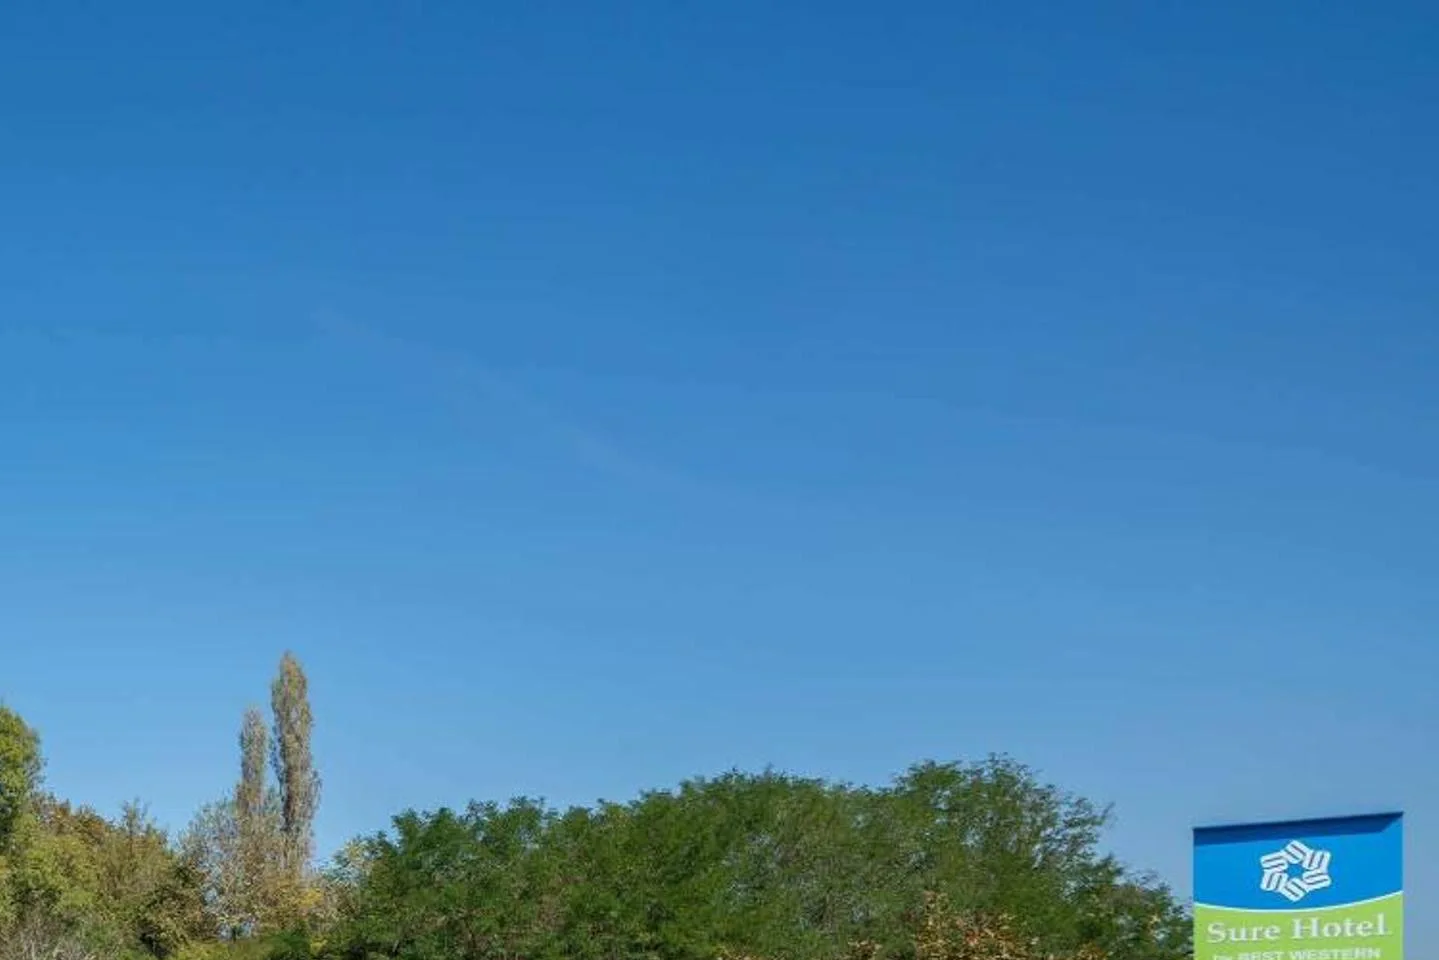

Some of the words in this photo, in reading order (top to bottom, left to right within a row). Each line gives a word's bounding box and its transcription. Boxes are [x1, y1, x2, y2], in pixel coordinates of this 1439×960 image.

[1207, 921, 1281, 943] Sure
[1291, 913, 1387, 940] Hotel
[1290, 947, 1382, 960] WESTERN
